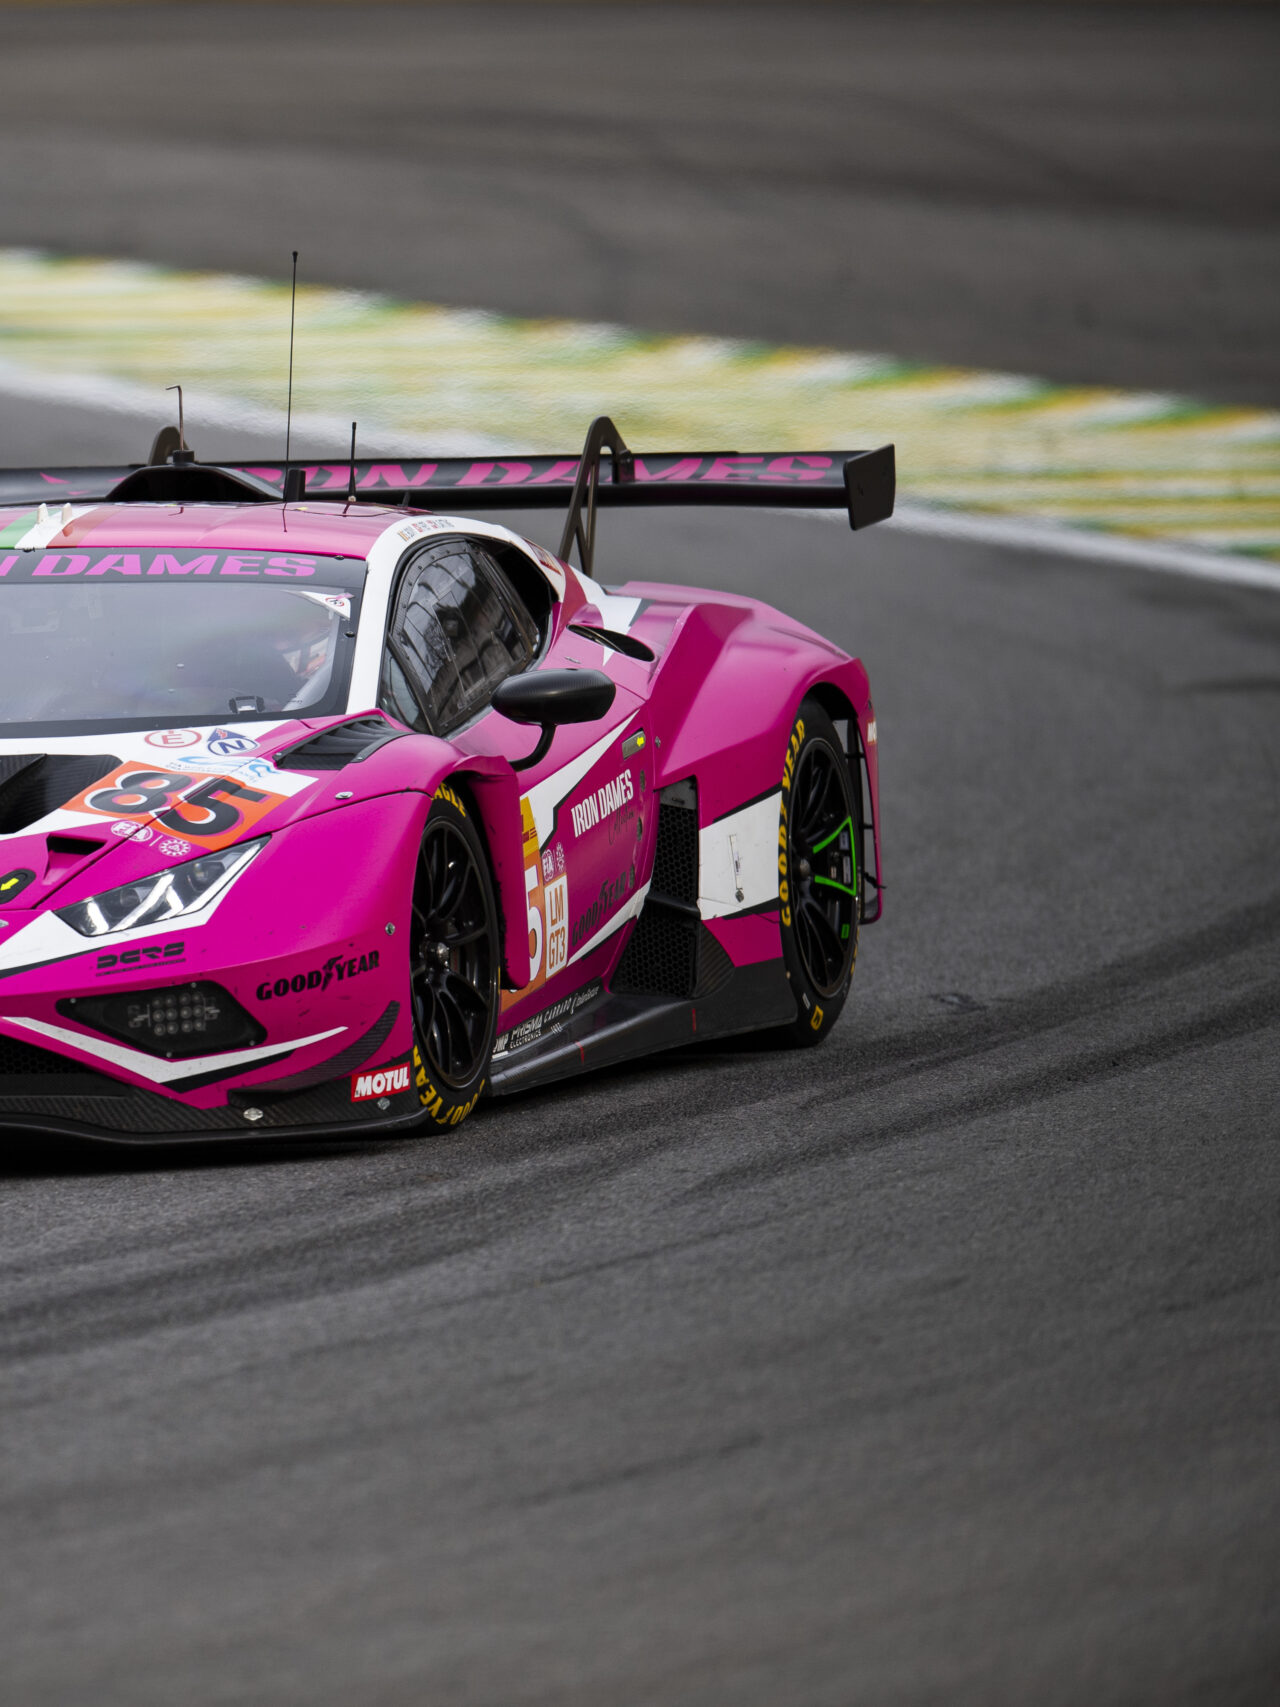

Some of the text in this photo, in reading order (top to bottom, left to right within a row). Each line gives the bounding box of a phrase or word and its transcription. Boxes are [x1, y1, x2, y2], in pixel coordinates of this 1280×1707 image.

[31, 554, 318, 577] DAMES
[84, 769, 271, 837] 85
[571, 792, 600, 838] IRON
[597, 768, 634, 820] DAMES
[549, 884, 565, 927] LM
[548, 929, 566, 971] GT3
[256, 950, 380, 1001] GOODYEAR
[353, 1066, 410, 1098] MOTUL
